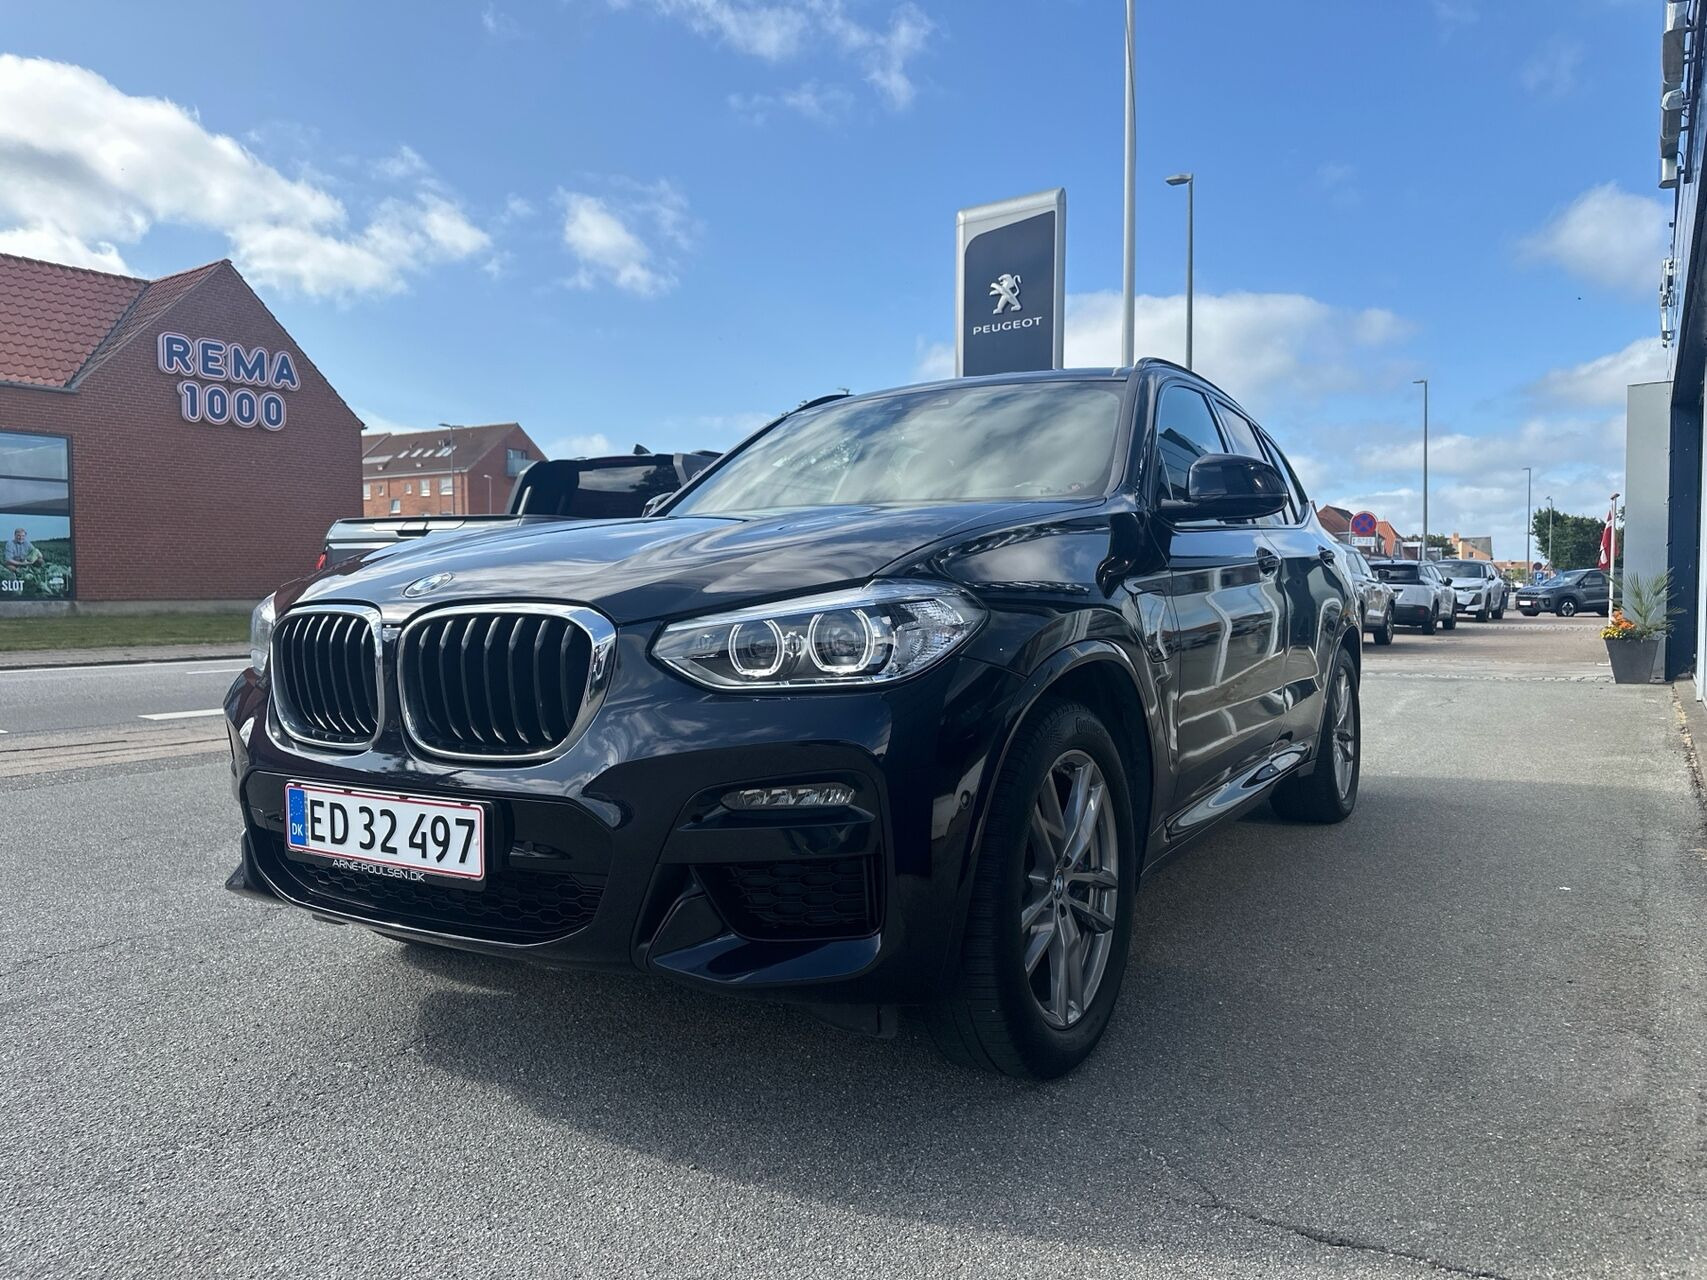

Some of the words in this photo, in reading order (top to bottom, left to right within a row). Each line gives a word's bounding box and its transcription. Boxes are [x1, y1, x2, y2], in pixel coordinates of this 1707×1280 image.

[972, 316, 1043, 335] PEUGEOT
[158, 331, 300, 391] REMA
[177, 380, 287, 431] 1000
[1, 579, 25, 592] SLOT
[291, 823, 304, 837] DK
[309, 799, 349, 845] ED
[358, 805, 398, 855] 32
[408, 813, 475, 864] 497
[332, 859, 425, 882] ARNE-POULSEN.DK
